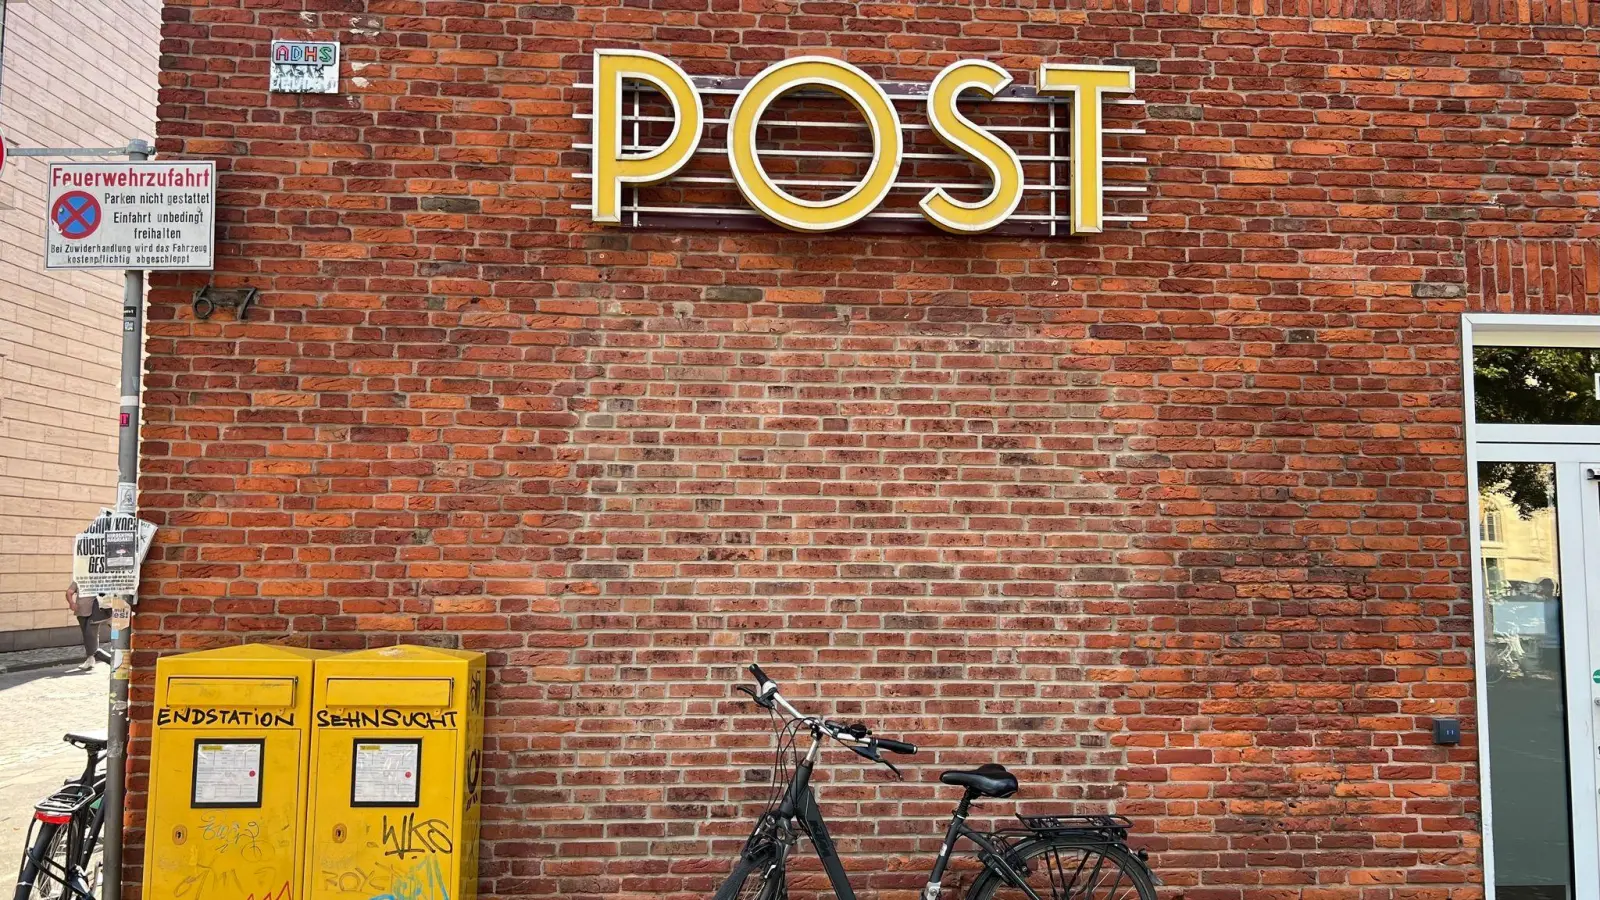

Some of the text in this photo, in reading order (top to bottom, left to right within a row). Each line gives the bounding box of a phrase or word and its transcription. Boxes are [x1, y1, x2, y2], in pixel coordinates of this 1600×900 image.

[276, 45, 332, 62] ADHS
[592, 48, 1136, 236] POST
[53, 167, 209, 187] Feuerwehrzufahrt
[104, 192, 210, 206] Parken nicht gestattet
[114, 211, 203, 224] Einfahrt unbedingt
[133, 228, 181, 239] freihalten
[51, 244, 207, 254] Bei Zuwiderhandlung wird das Fahrzeug
[67, 253, 190, 264] kostenpflichtig abgeschleppt
[157, 707, 295, 726] ENDSTATION
[316, 709, 458, 729] SEHNSUCHT
